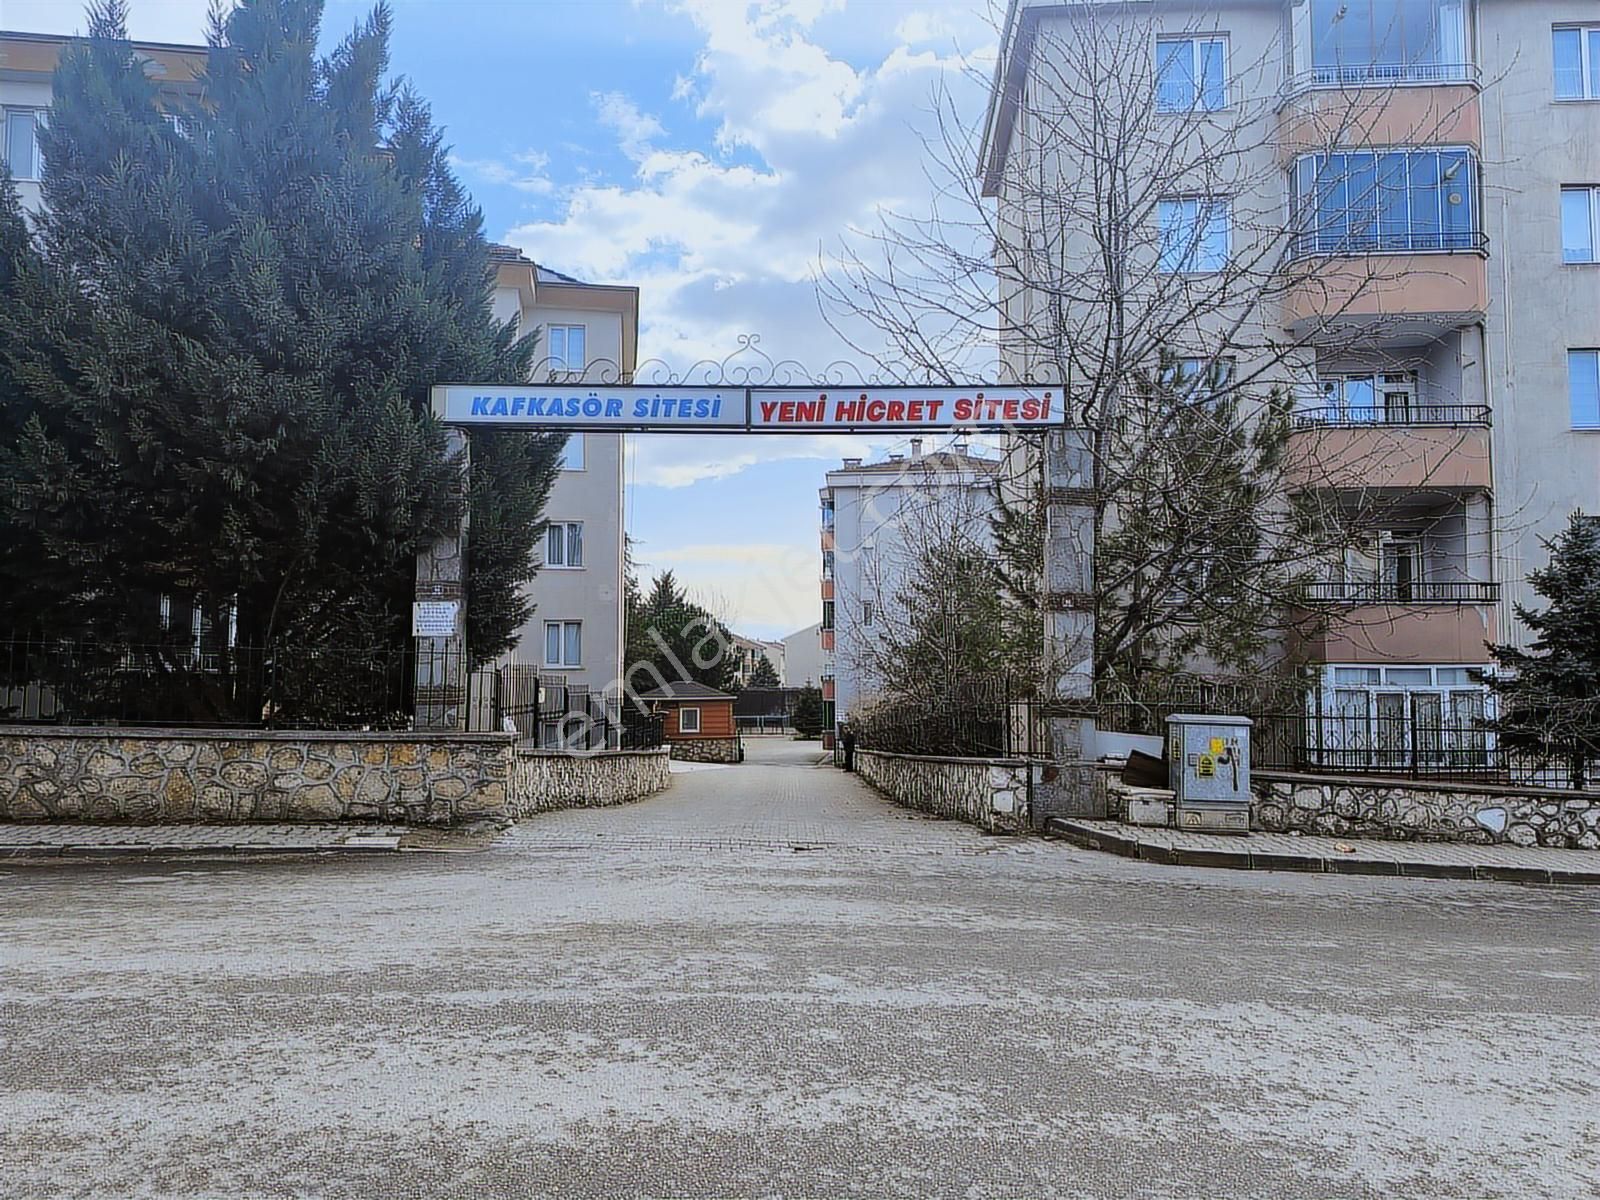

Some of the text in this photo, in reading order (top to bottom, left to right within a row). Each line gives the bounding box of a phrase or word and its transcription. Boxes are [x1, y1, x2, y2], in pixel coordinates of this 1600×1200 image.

[470, 392, 722, 418] KAFKASÖR SİTESİ
[760, 392, 1052, 422] YENİ HİCRET SİTESİ
